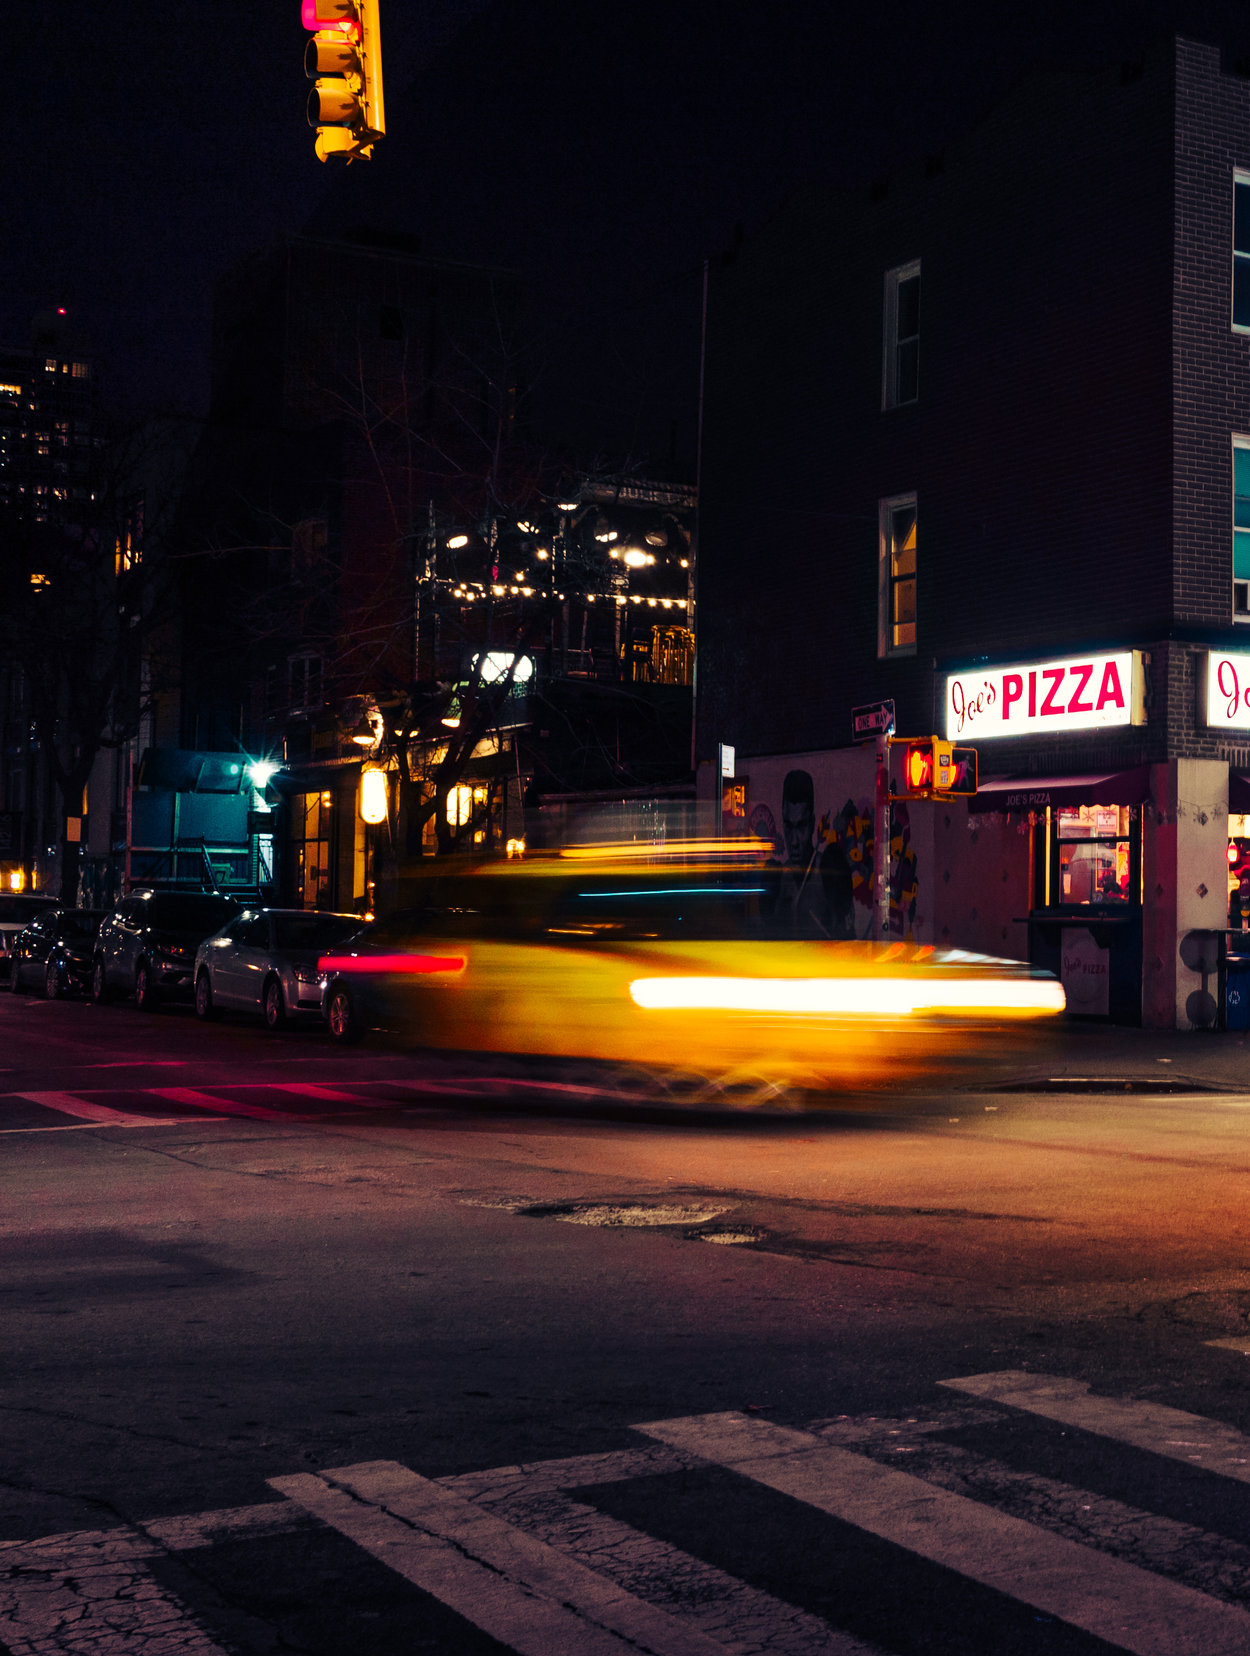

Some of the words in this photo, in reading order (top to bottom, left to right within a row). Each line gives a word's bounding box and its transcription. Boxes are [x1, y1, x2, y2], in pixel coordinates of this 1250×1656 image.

[951, 680, 997, 733] Joe's
[1002, 661, 1126, 721] PIZZA
[857, 717, 870, 729] ONE
[874, 711, 888, 725] WAY
[1006, 793, 1028, 806] JOE'S
[1029, 792, 1051, 804] PIZZA
[1082, 963, 1106, 975] PIZZA
